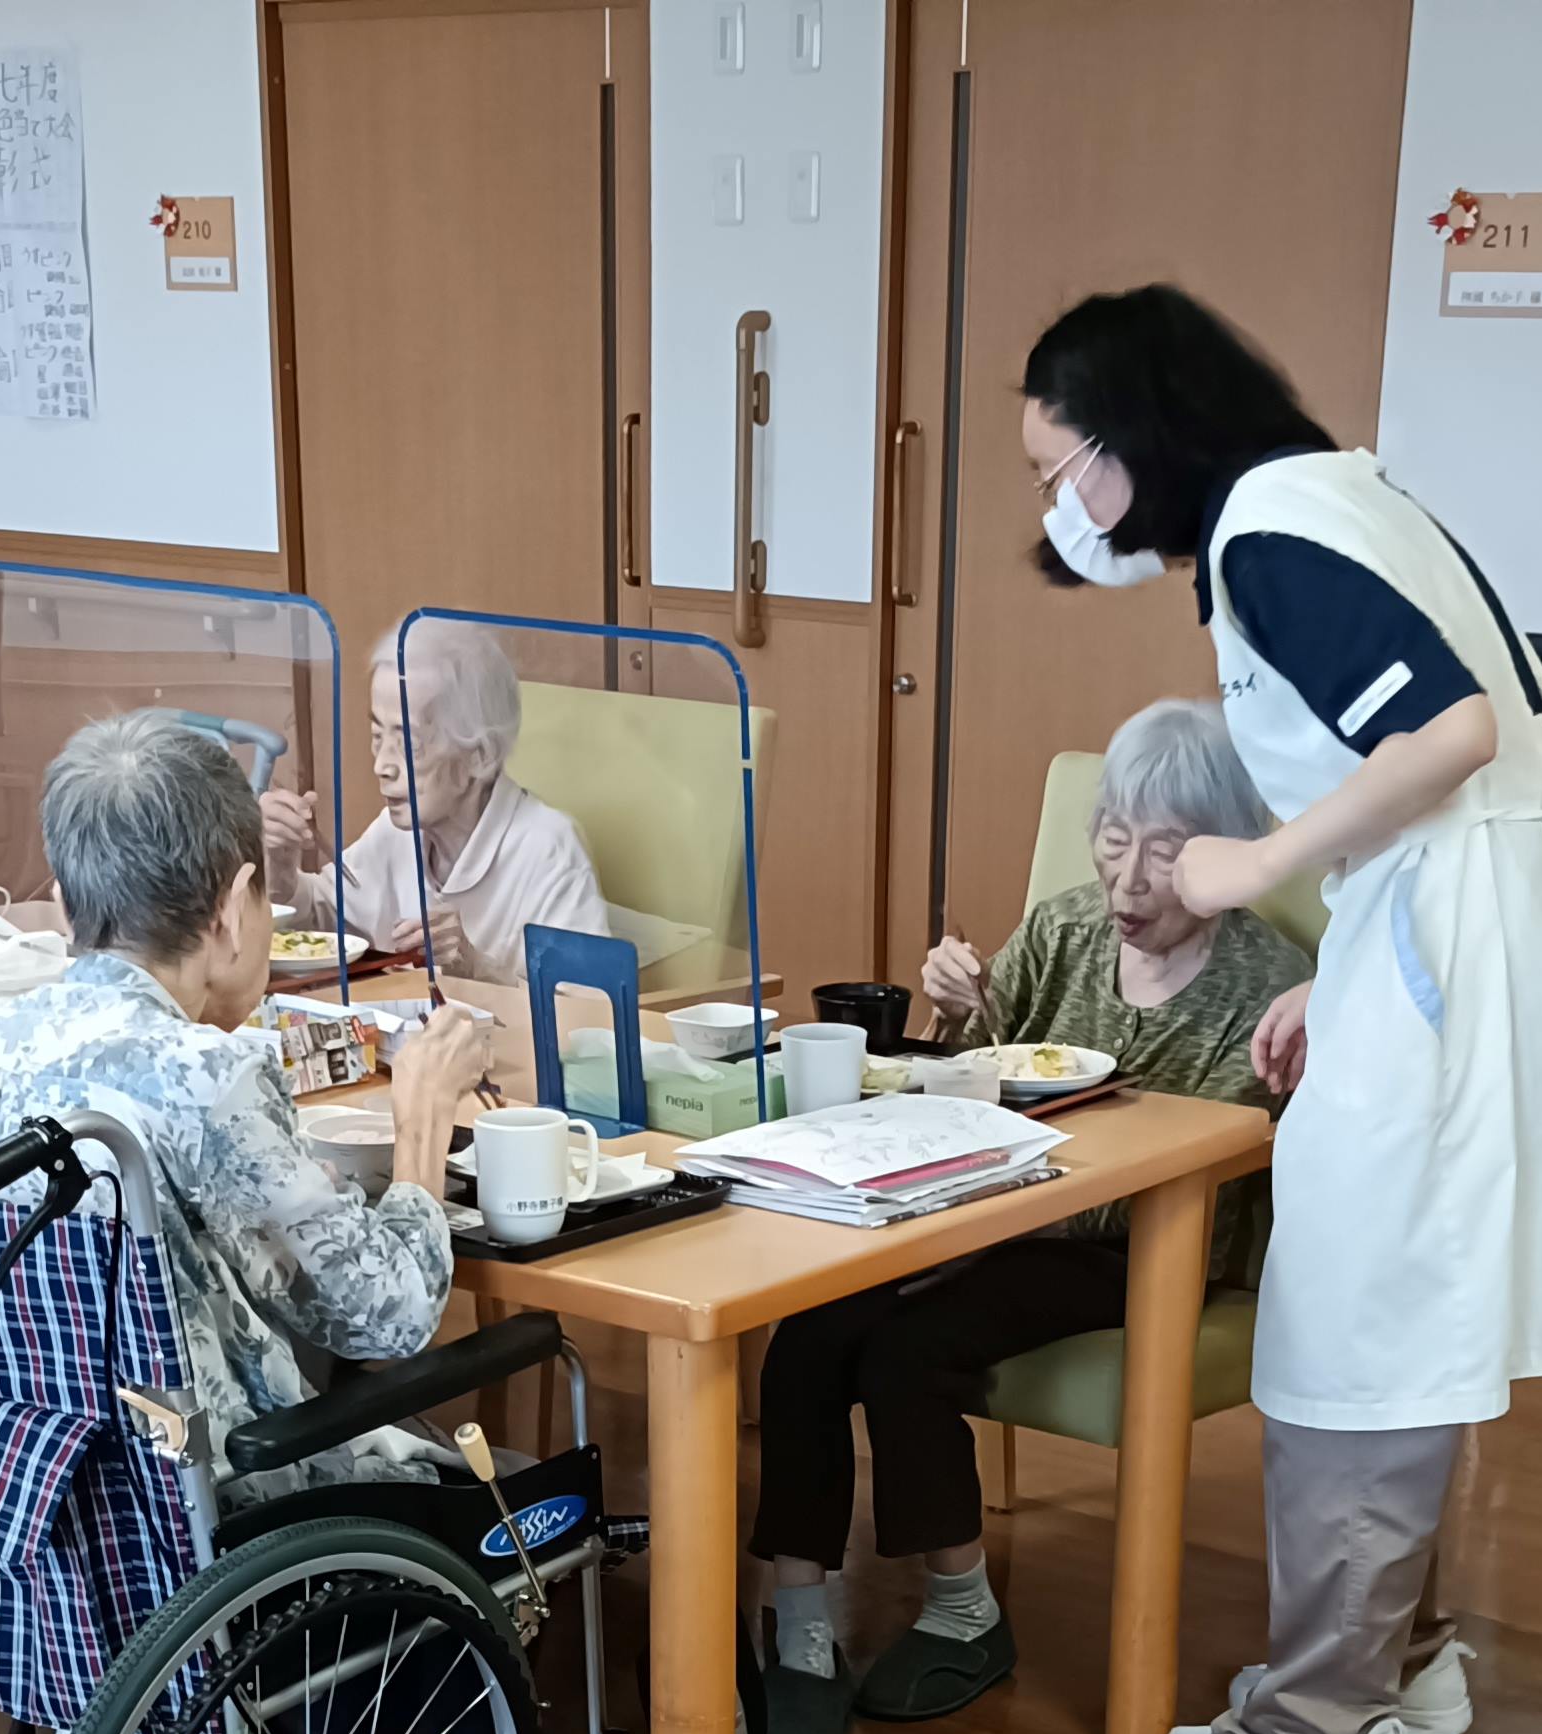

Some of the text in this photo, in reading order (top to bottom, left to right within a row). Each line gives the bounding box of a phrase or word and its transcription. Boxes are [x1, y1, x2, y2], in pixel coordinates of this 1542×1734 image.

[182, 220, 212, 240] 210
[1482, 224, 1529, 248] 211
[665, 1095, 704, 1112] nepia
